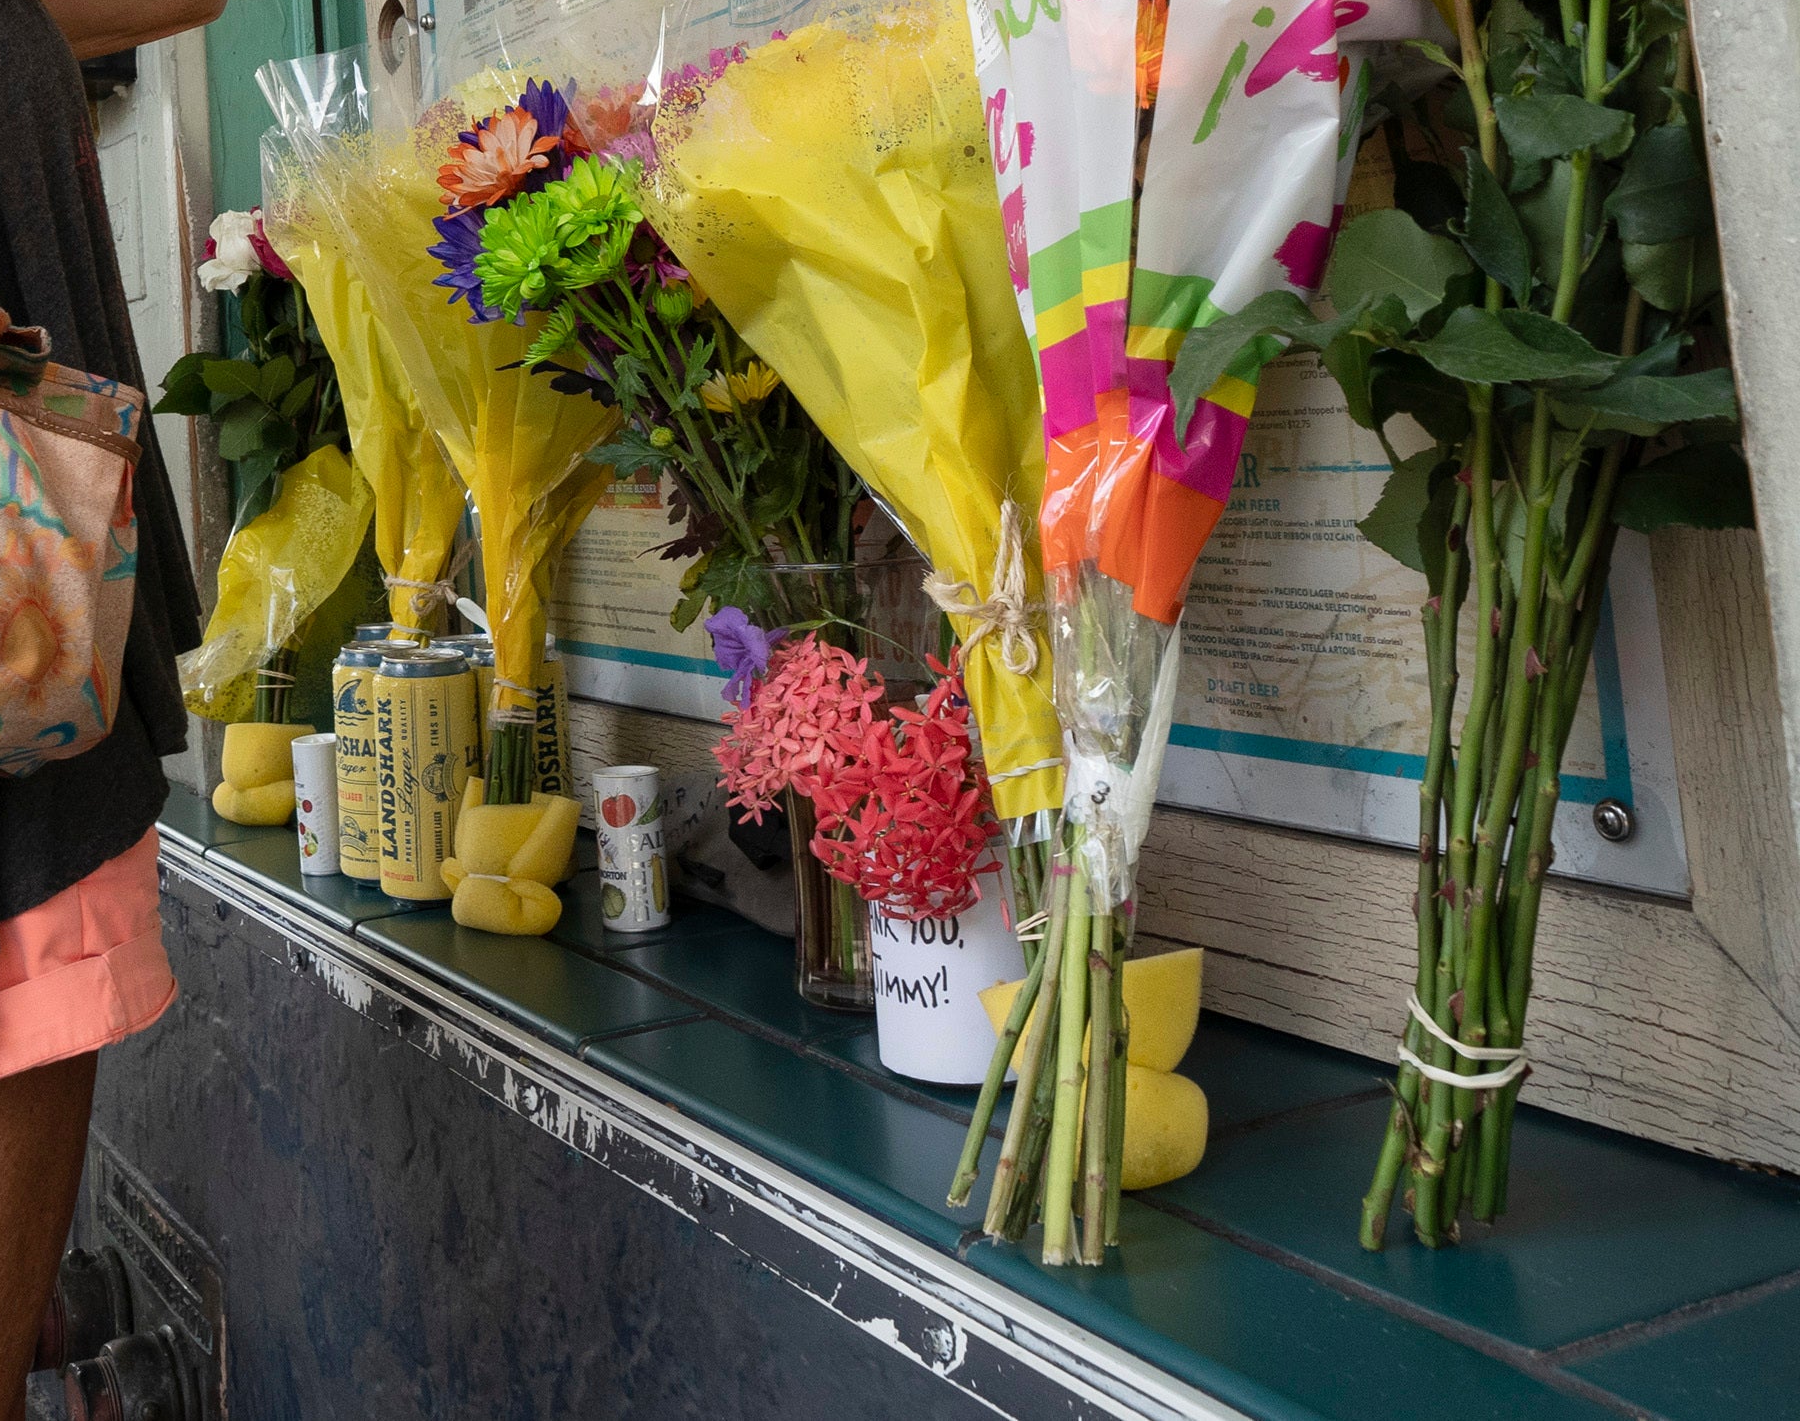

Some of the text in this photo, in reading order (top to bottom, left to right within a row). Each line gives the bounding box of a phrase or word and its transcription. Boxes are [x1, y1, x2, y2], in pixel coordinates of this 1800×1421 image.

[1274, 586, 1308, 596] PACIFICO
[1309, 588, 1334, 598] LAGER
[429, 698, 439, 746] FINS UP!
[535, 683, 562, 795] DSHARK
[376, 692, 399, 861] LANDSHARK
[396, 746, 420, 815] Lager
[403, 819, 413, 863] PREMIUM
